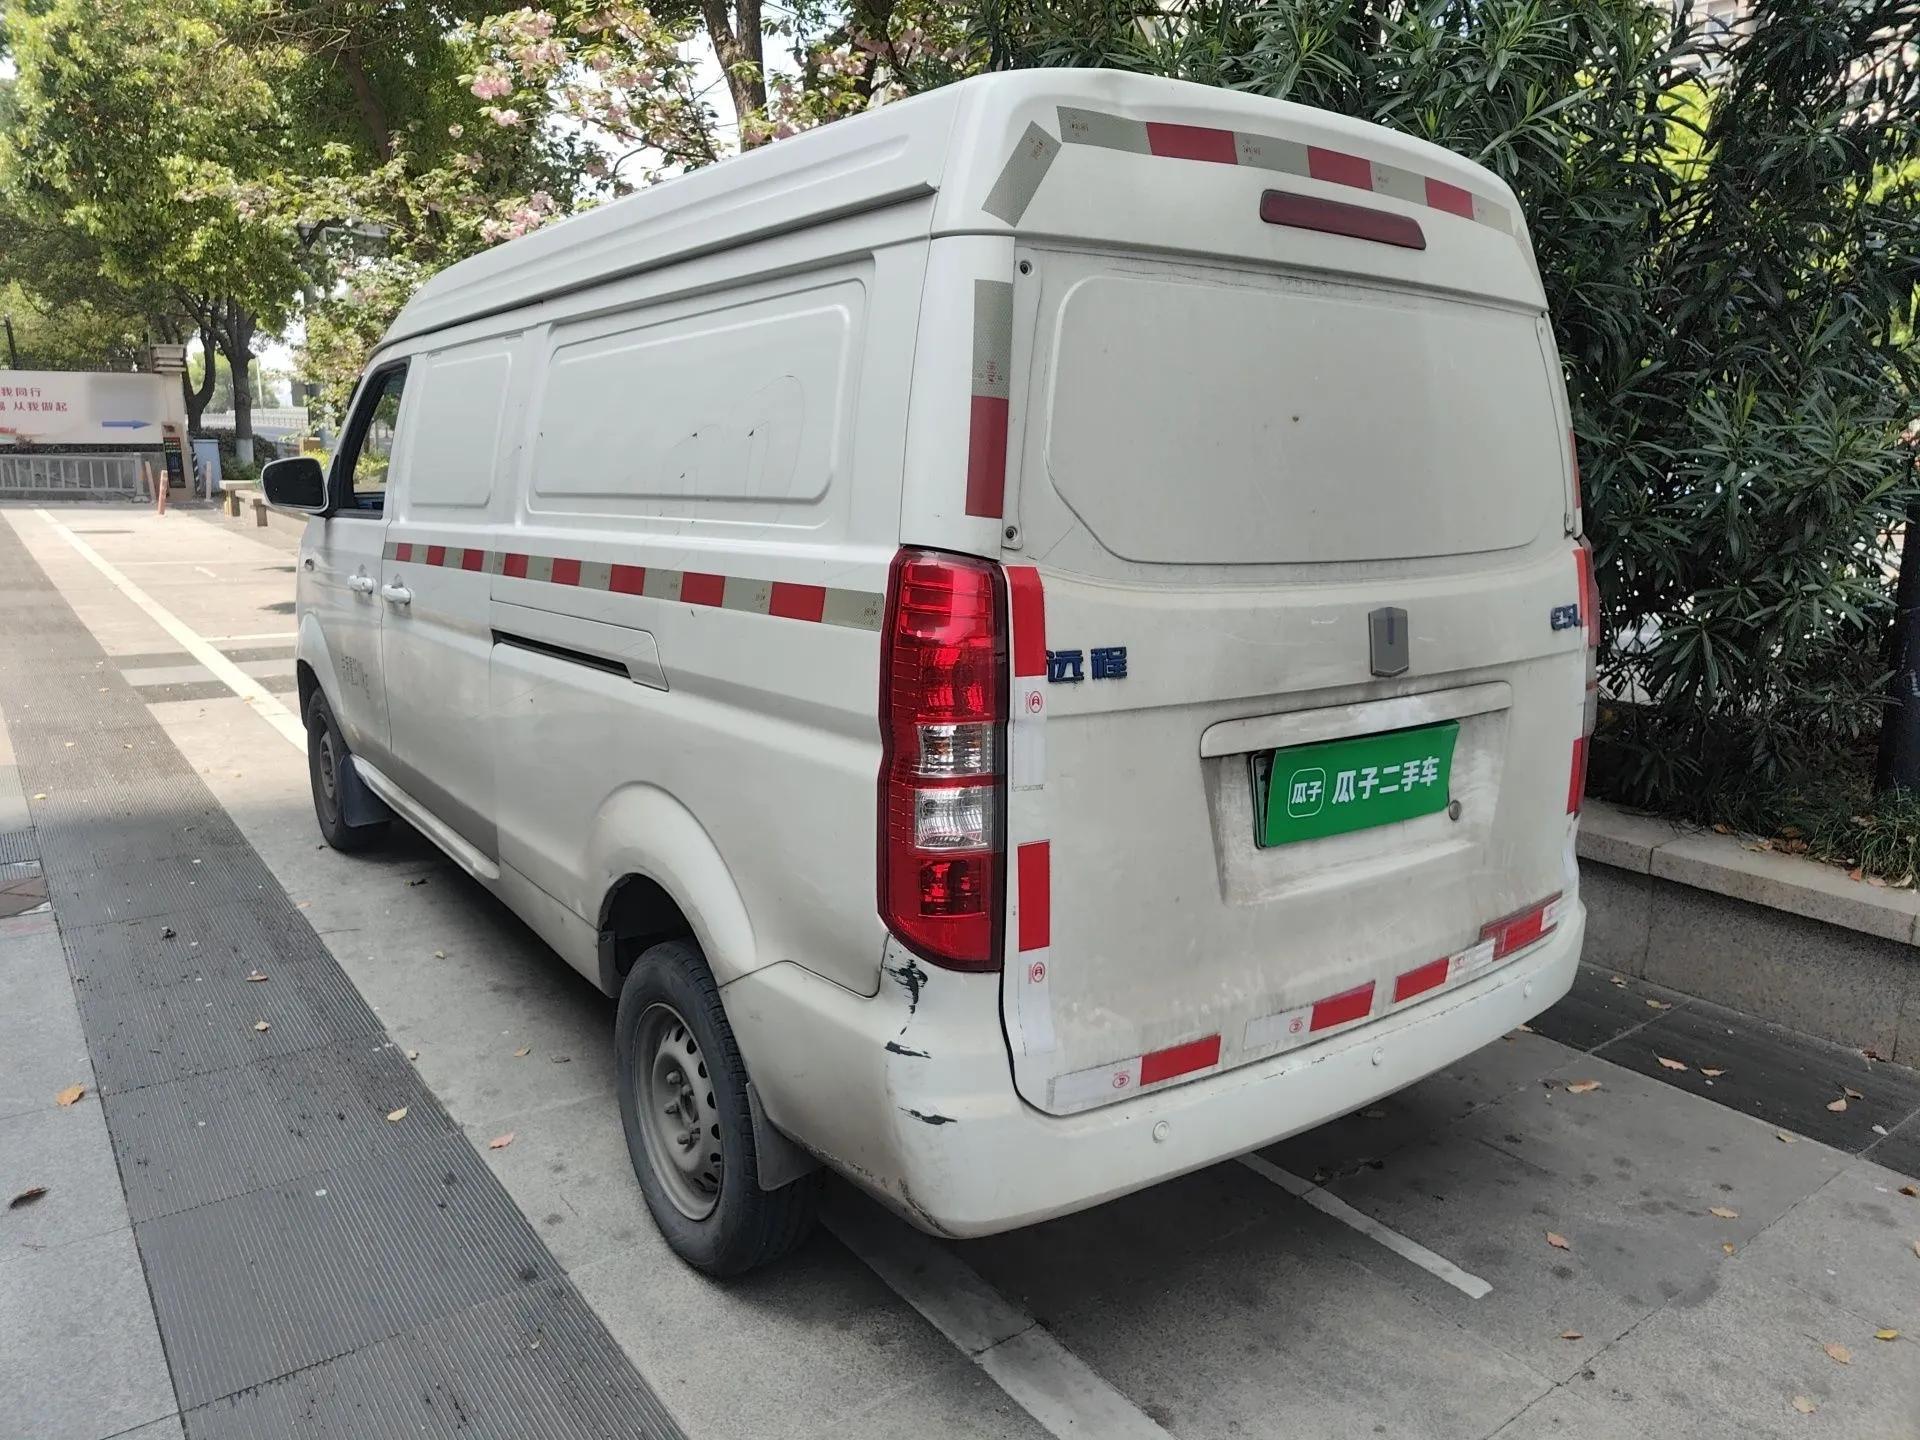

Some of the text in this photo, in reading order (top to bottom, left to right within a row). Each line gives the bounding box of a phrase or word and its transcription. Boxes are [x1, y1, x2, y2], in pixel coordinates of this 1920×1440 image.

[14, 401, 67, 412] 从我做起
[1046, 646, 1127, 683] 远程
[1291, 780, 1322, 804] 瓜子
[1332, 756, 1440, 804] 瓜子二手车
